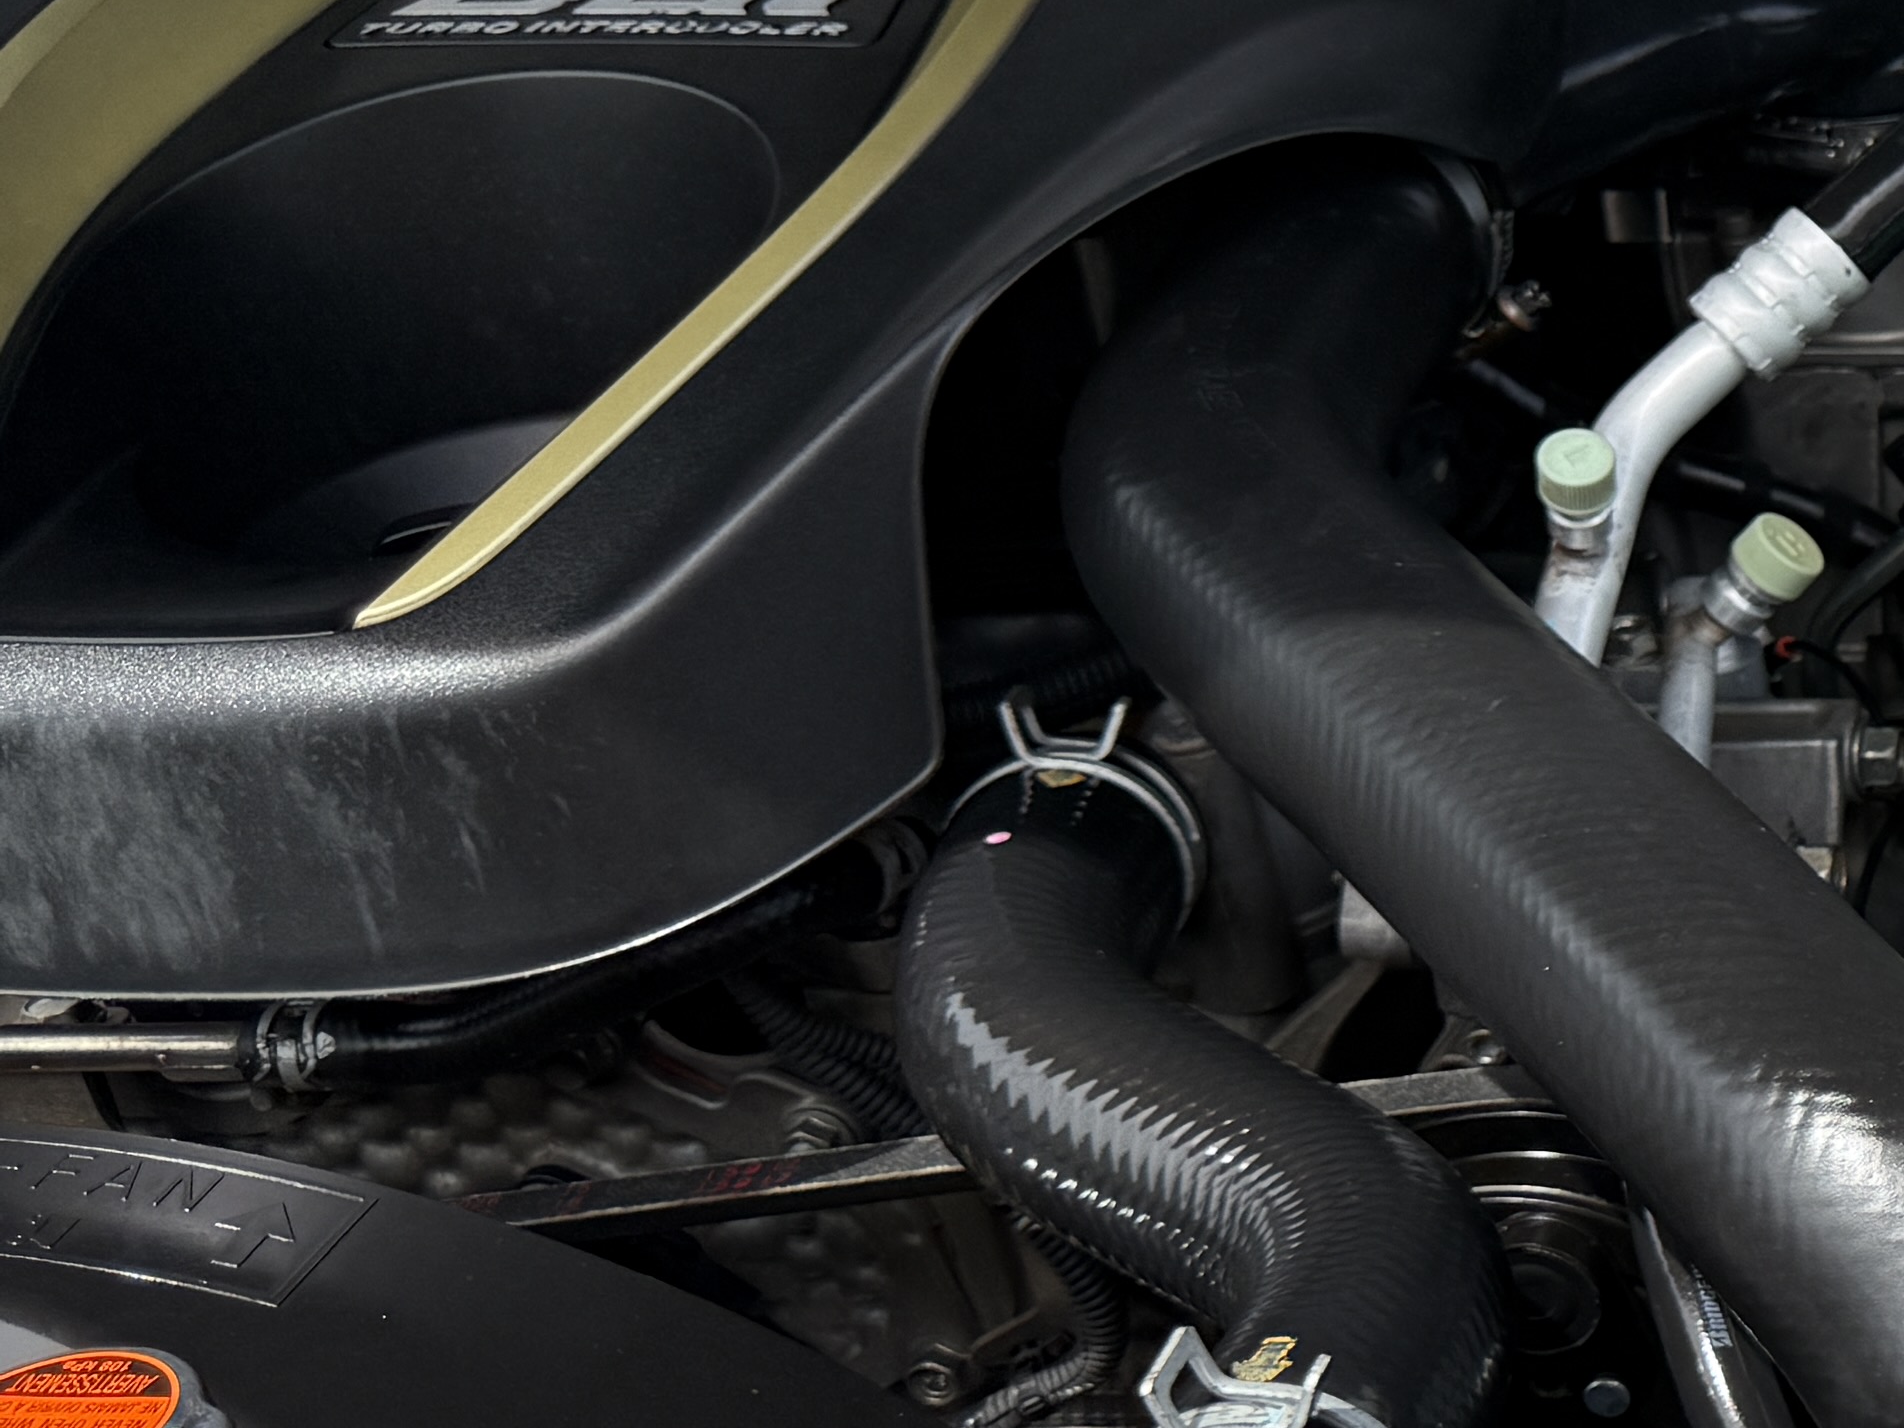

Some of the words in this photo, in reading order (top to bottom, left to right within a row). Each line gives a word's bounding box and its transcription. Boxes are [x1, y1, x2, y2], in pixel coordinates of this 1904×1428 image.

[360, 19, 522, 39] TURBO
[525, 19, 848, 39] INTERCOOLER
[4, 1373, 160, 1395] AVERTISSEMENT
